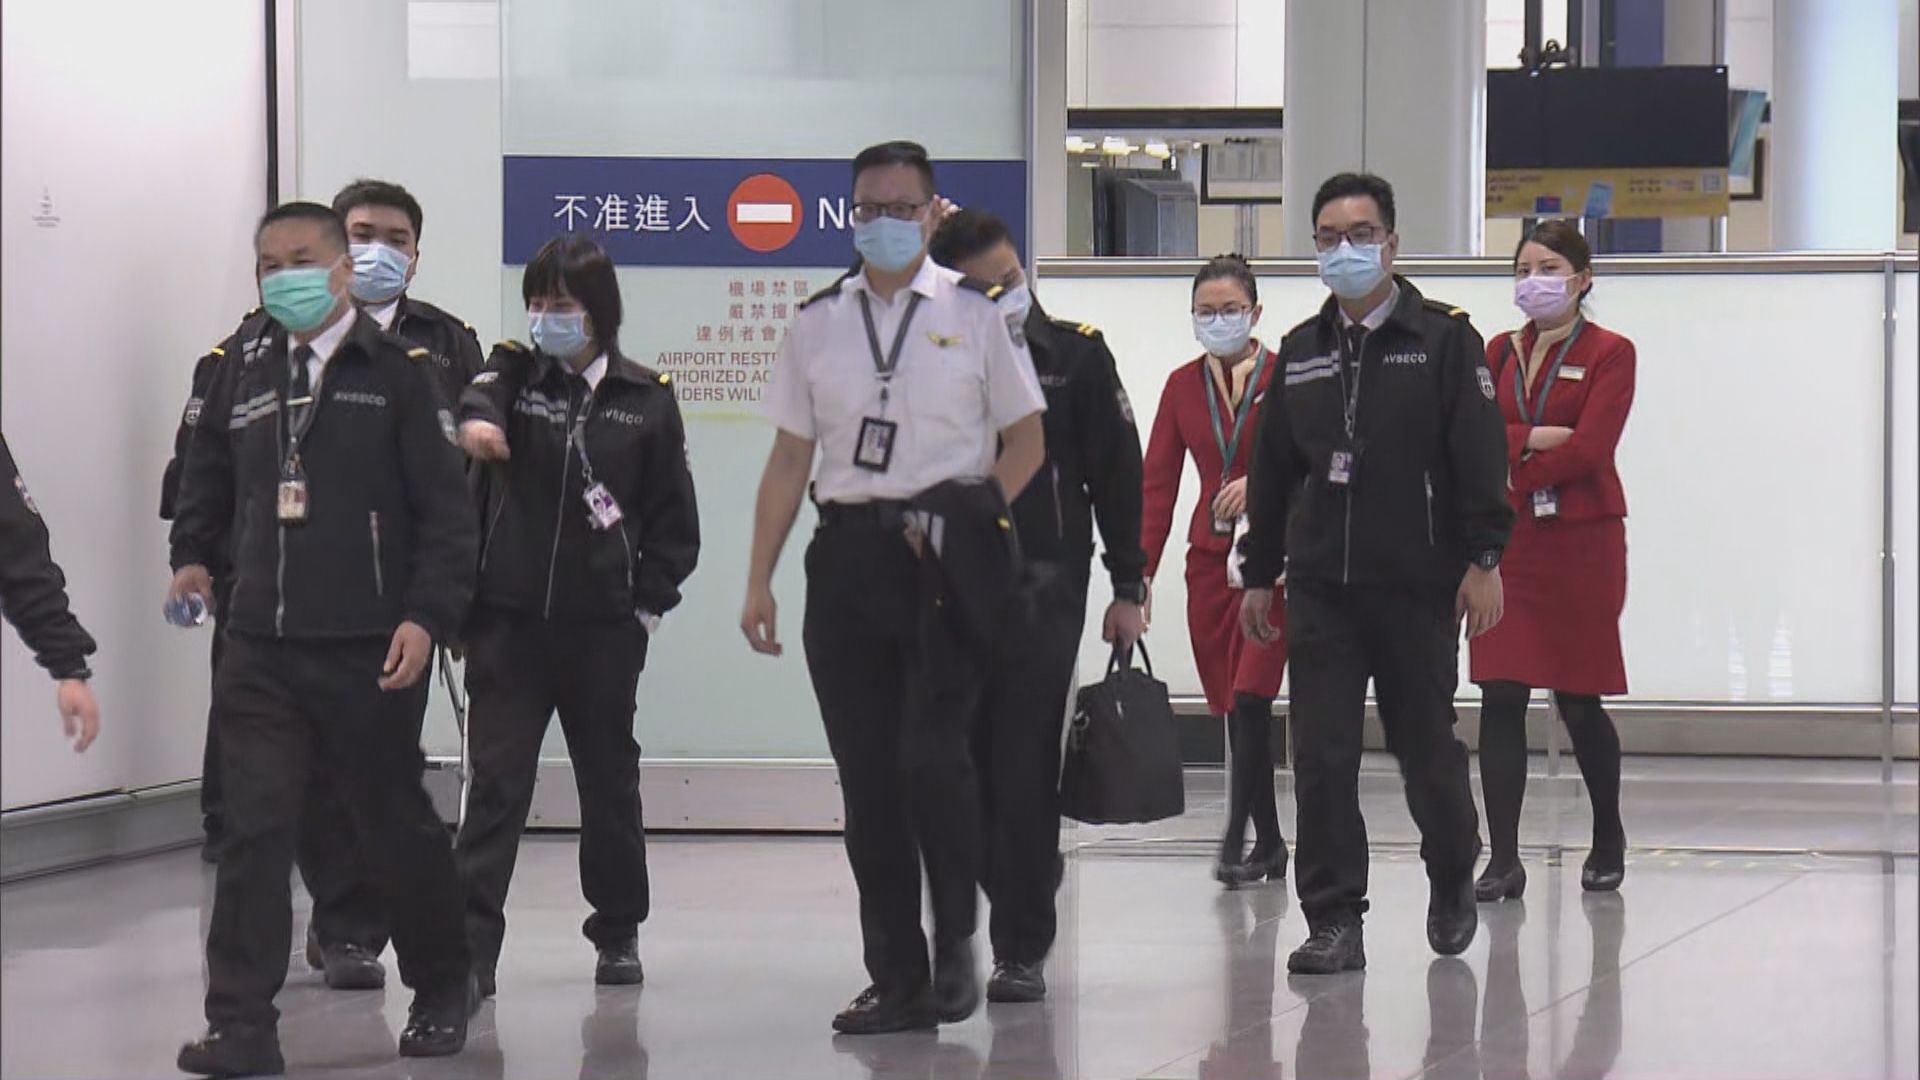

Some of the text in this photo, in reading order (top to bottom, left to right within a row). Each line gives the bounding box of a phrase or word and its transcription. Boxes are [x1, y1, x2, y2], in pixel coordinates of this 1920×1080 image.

[553, 195, 711, 232] 不准進入
[818, 197, 857, 230] N
[657, 352, 725, 365] AIRPORT
[661, 370, 746, 383] THORIZED
